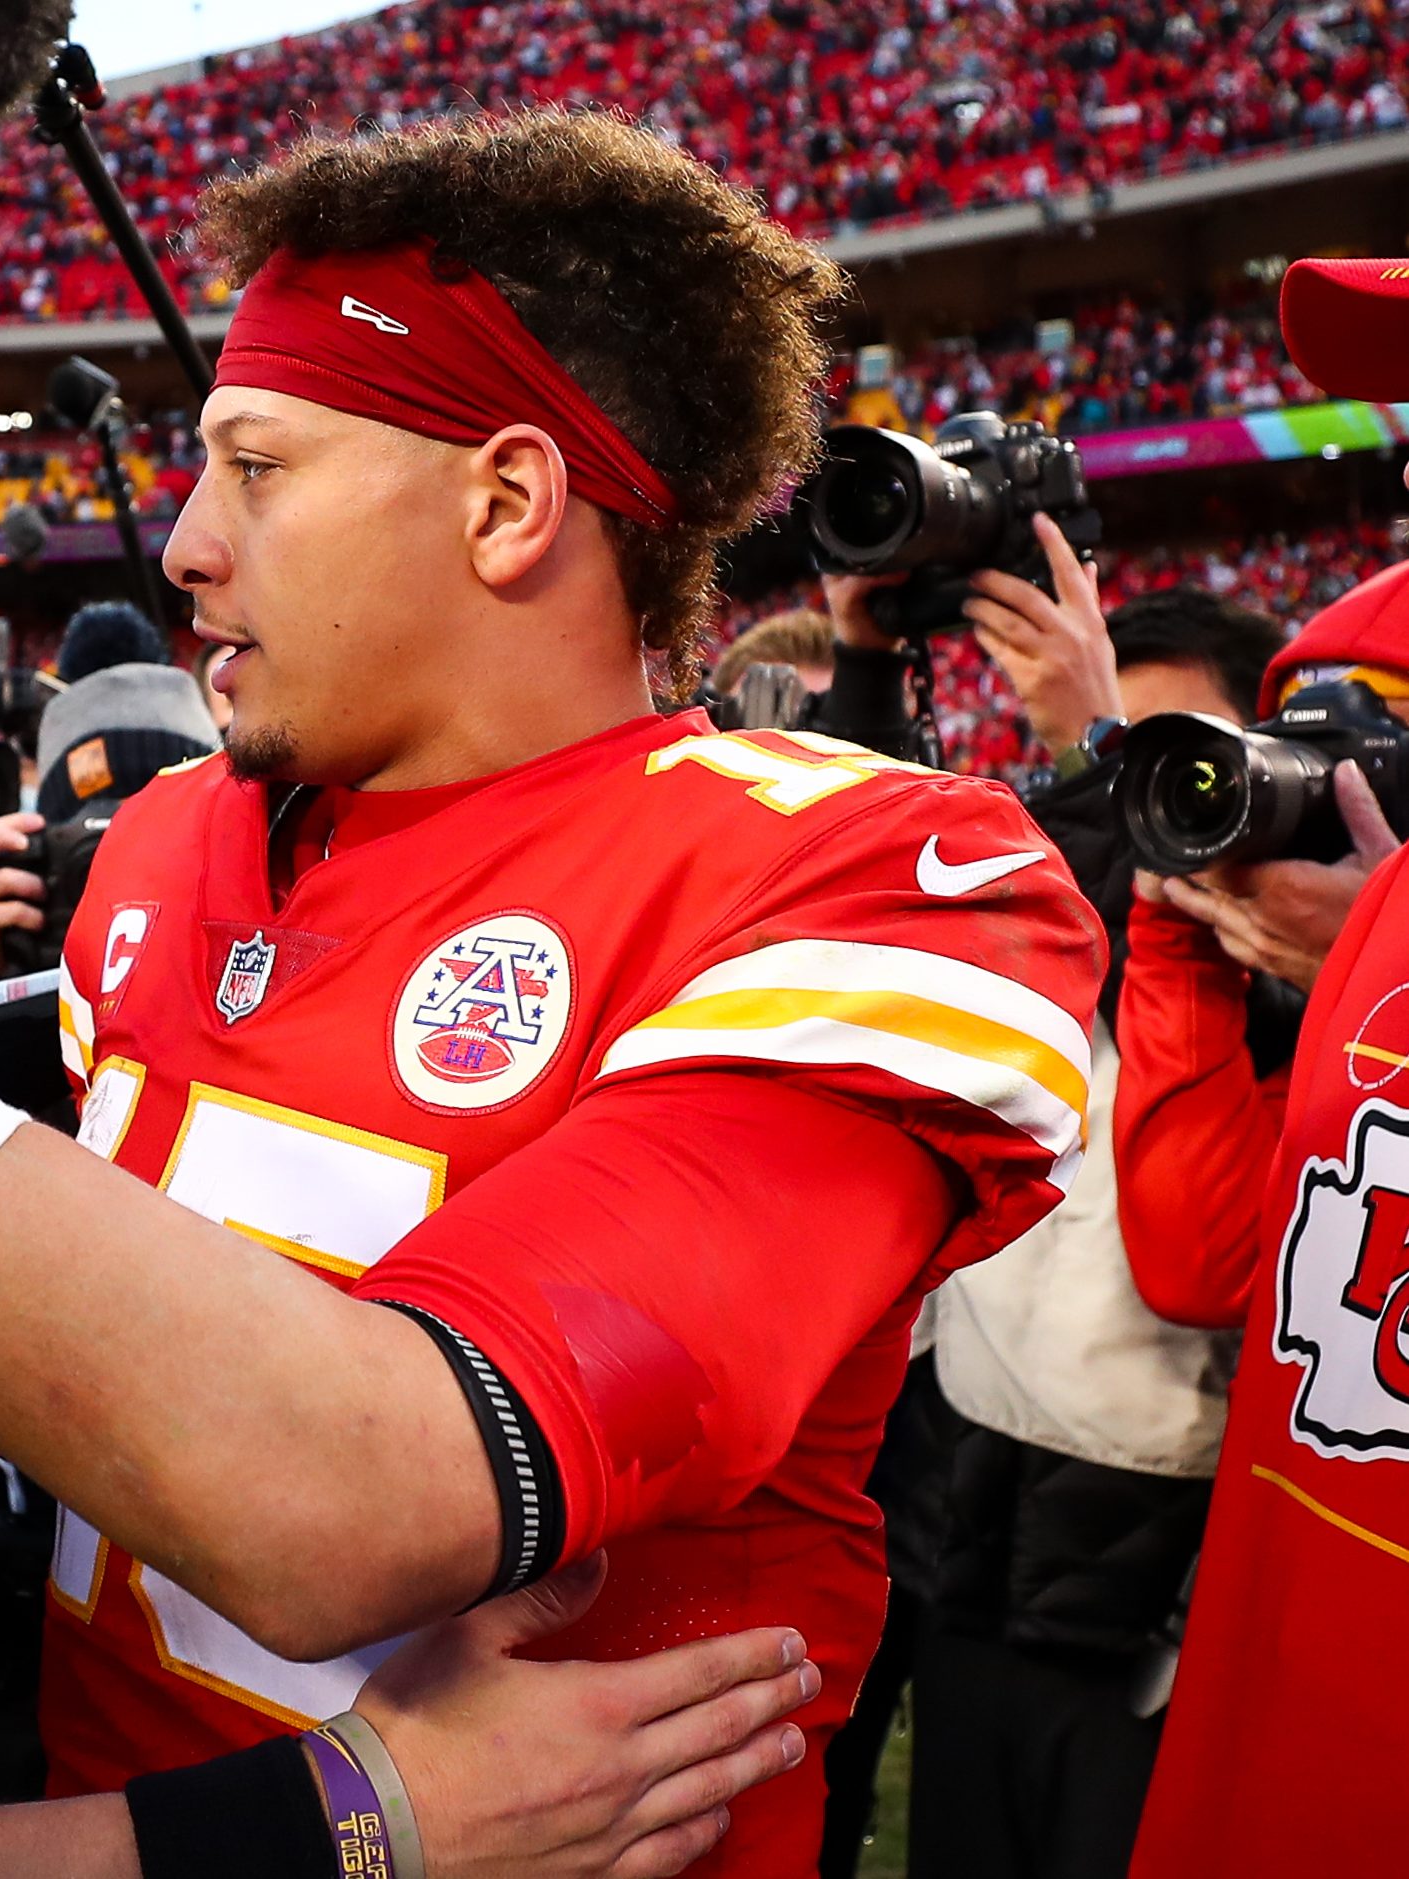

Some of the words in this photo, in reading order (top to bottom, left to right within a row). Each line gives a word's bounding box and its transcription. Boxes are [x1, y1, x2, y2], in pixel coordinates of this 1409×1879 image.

[1282, 709, 1328, 724] Canon
[101, 909, 148, 995] C
[225, 973, 260, 1006] NFL
[444, 1040, 486, 1069] LH
[337, 1810, 365, 1879] TIG
